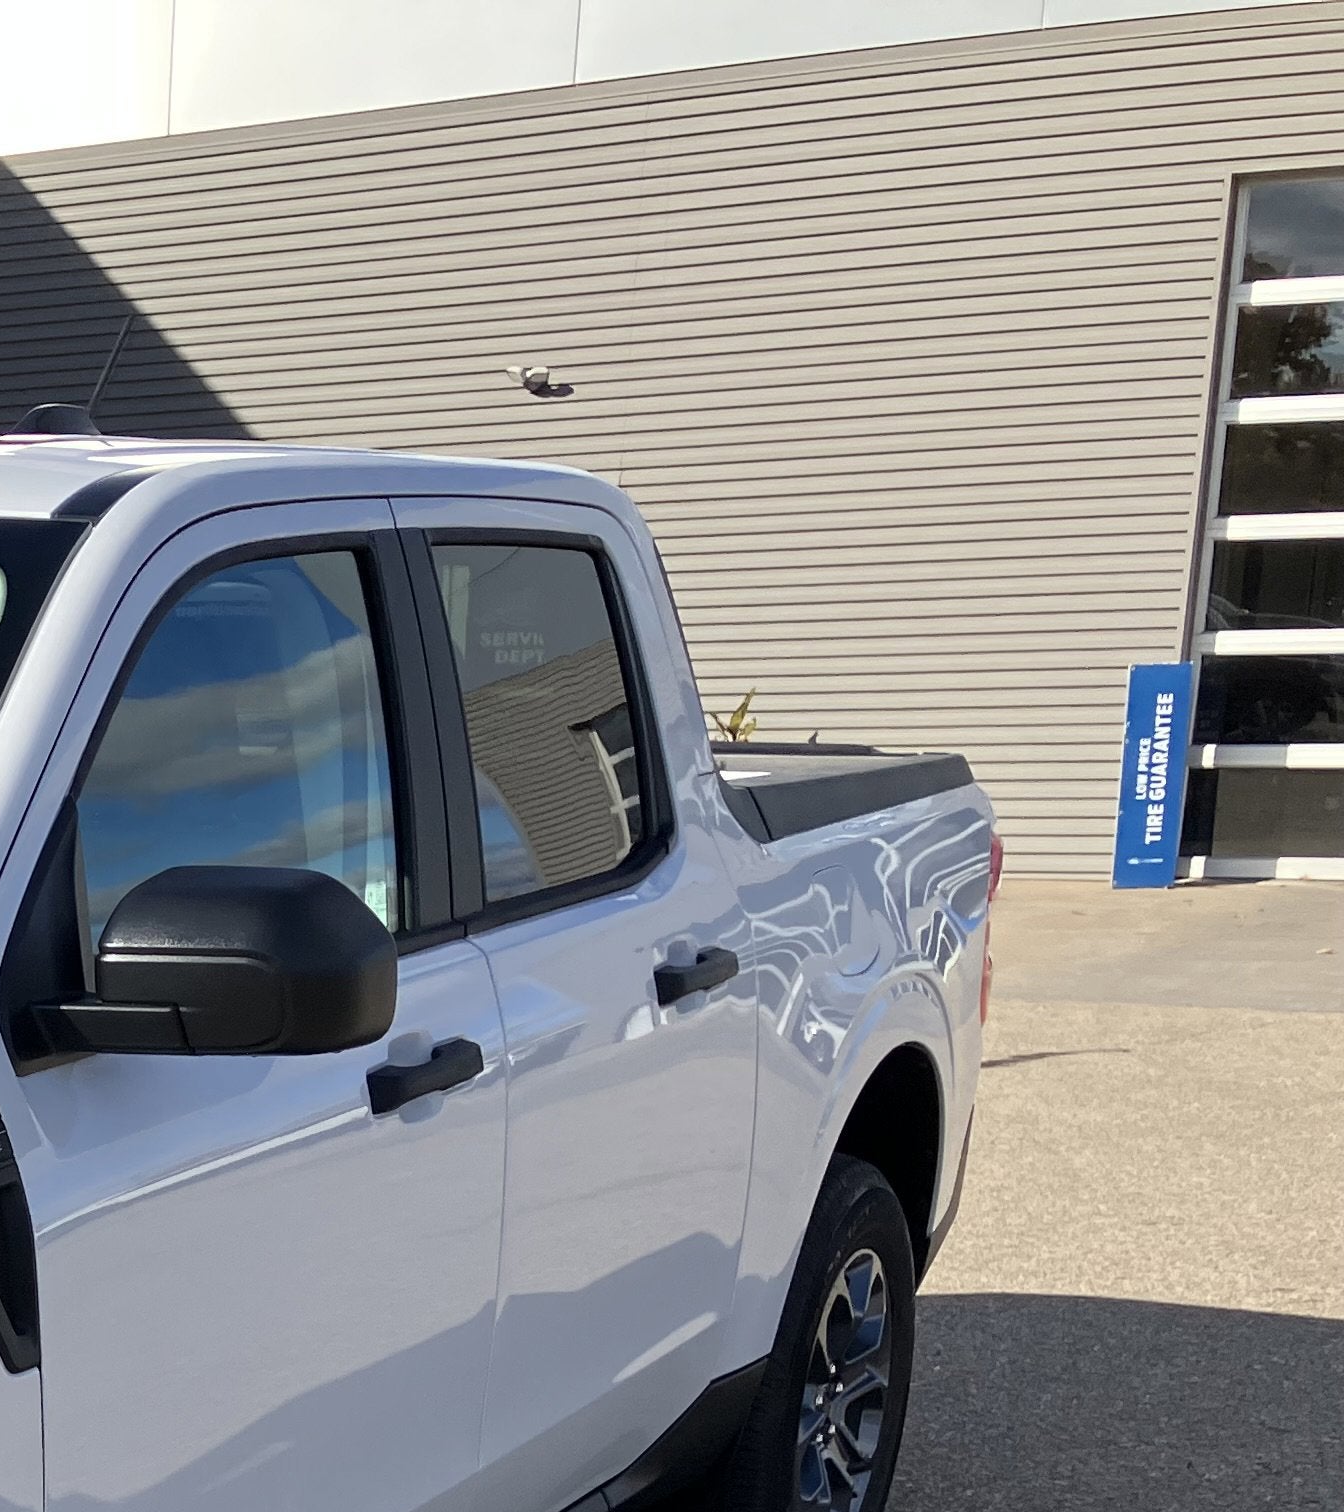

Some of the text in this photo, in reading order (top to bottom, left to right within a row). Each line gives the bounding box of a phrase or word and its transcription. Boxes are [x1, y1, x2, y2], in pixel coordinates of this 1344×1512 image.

[1135, 737, 1152, 801] LOW PRICE
[1144, 693, 1174, 845] TIRE GUARANTEE
